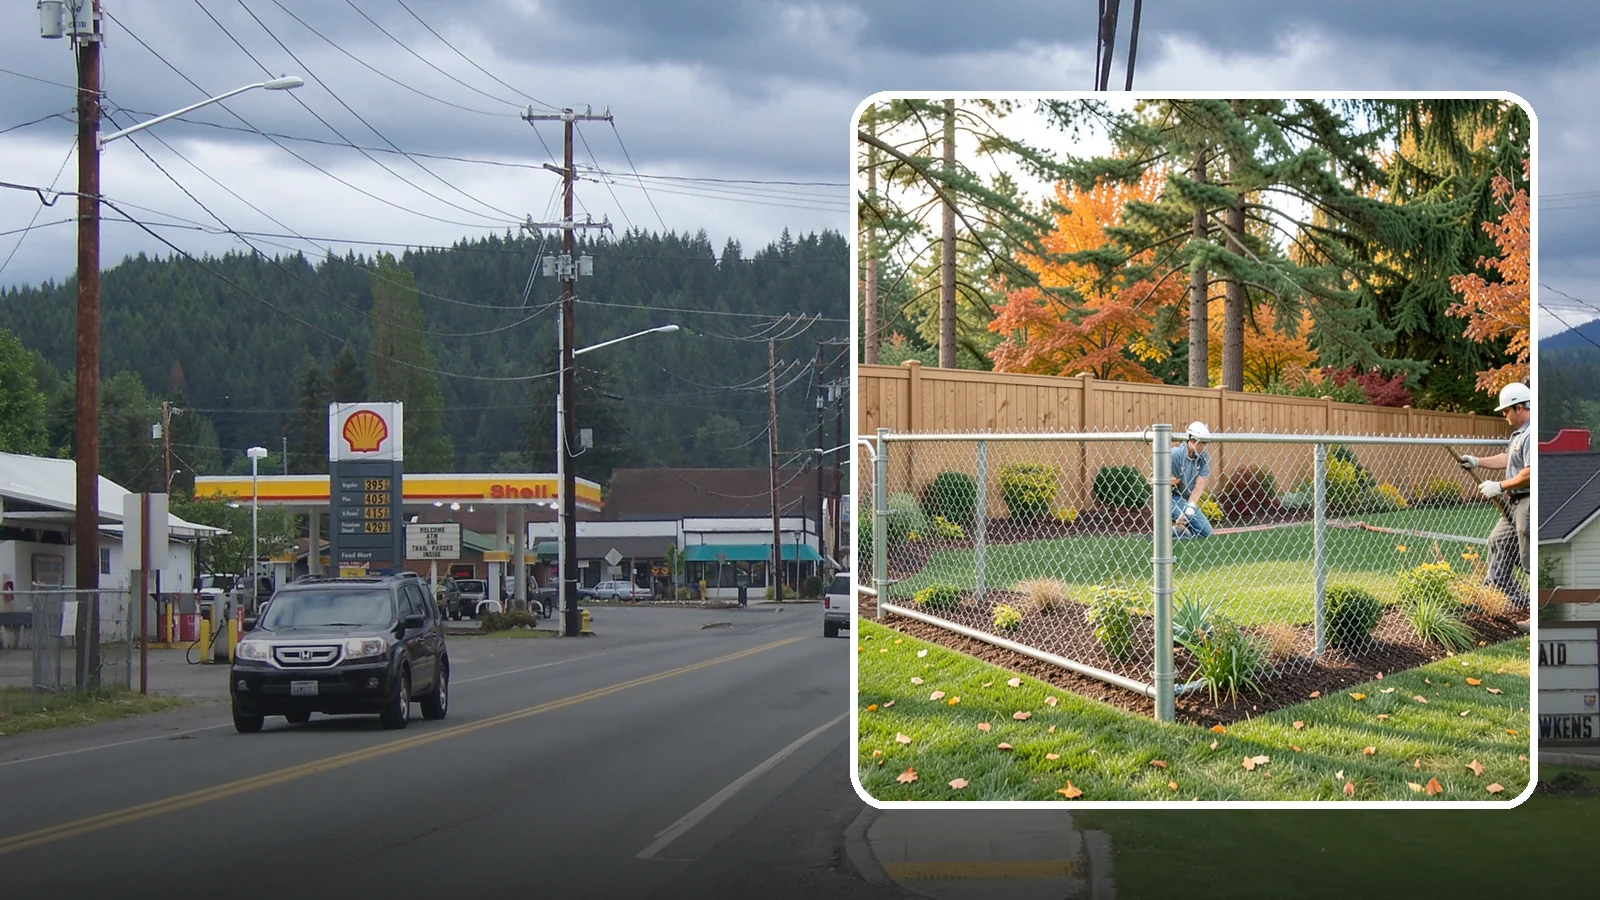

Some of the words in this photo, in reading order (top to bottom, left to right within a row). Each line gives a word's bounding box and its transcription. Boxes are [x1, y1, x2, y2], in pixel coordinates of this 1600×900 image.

[365, 480, 383, 490] 395
[490, 484, 547, 499] Shell
[365, 494, 383, 504] 405
[365, 508, 383, 518] 415
[365, 522, 383, 532] 429
